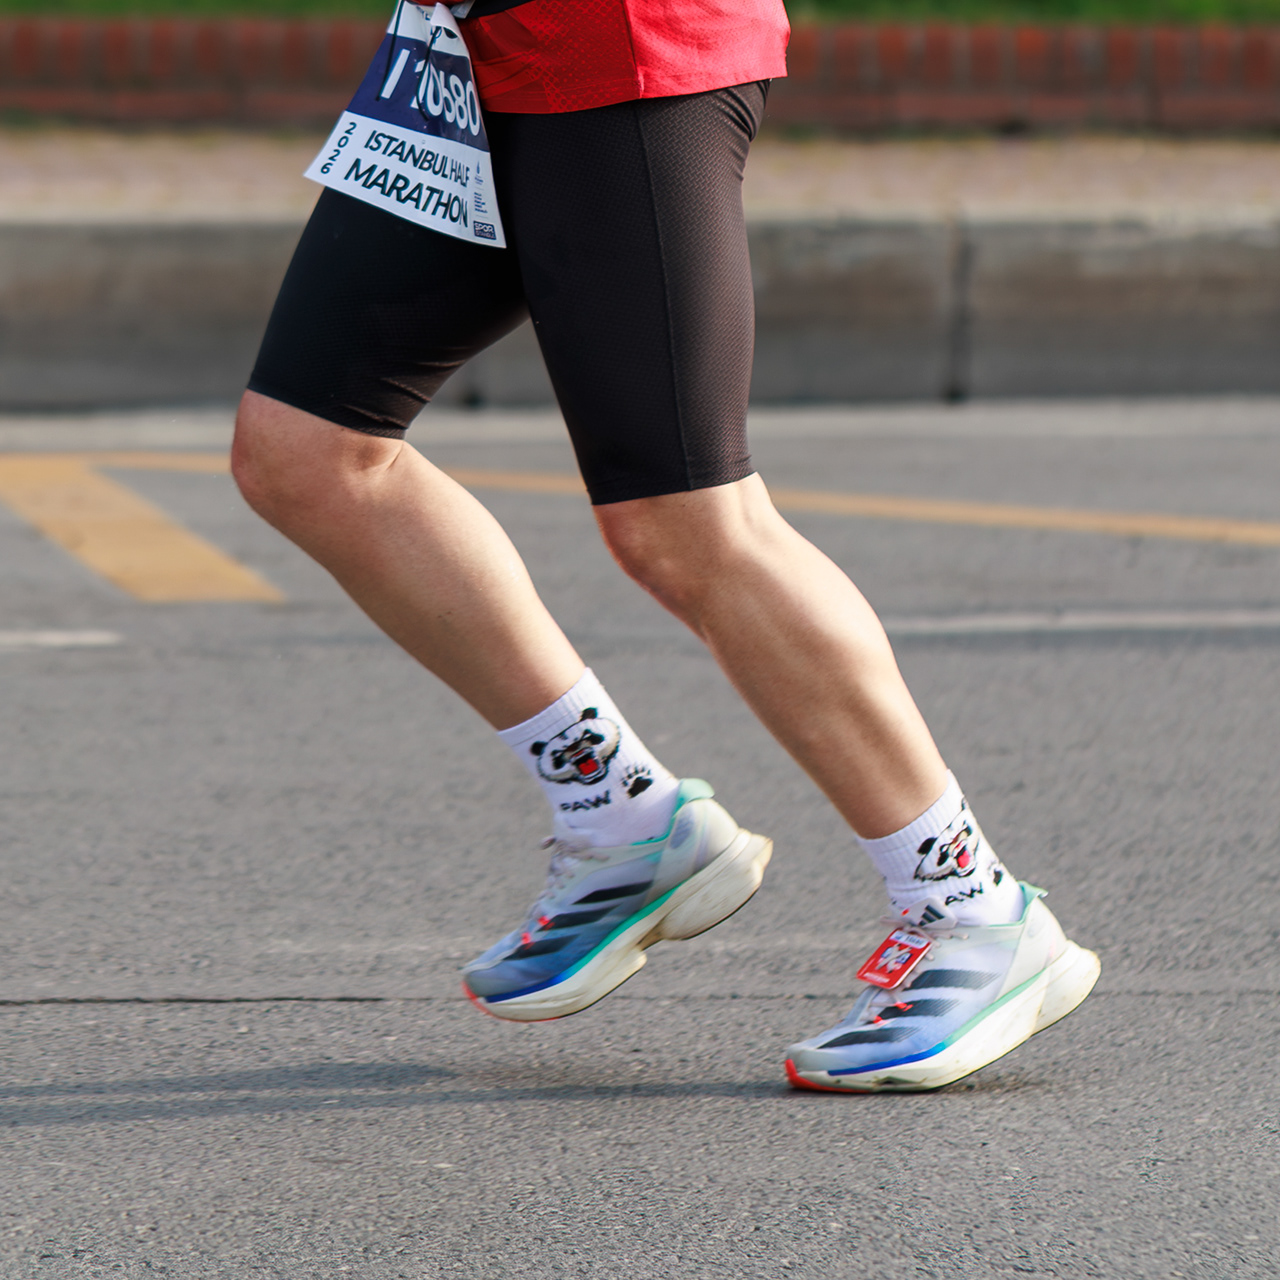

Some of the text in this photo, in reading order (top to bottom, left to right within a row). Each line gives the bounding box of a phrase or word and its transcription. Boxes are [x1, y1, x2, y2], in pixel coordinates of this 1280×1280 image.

[321, 121, 357, 175] 2026
[364, 130, 470, 188] ISTANBUL HALF
[344, 158, 468, 228] MARATHON
